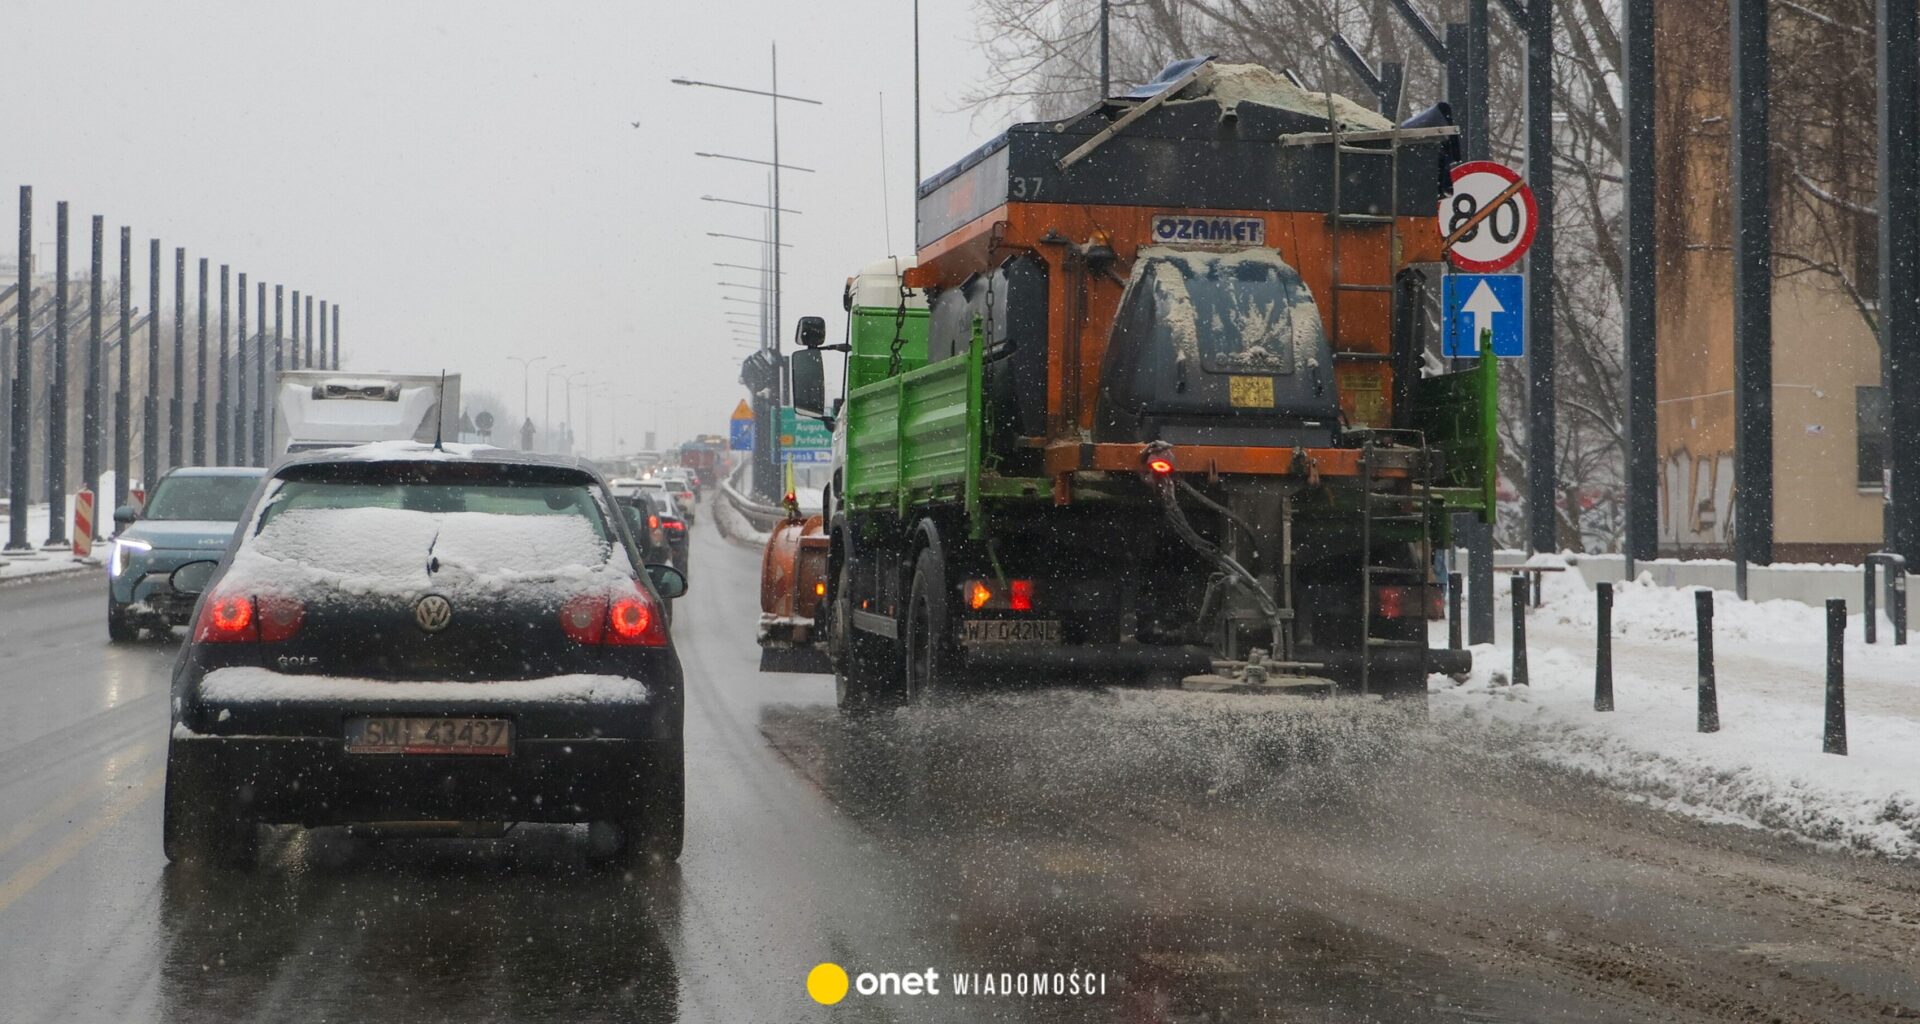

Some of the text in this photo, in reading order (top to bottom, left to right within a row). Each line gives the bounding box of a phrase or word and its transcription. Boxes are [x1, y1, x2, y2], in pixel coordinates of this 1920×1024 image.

[1012, 177, 1043, 198] 37
[1449, 193, 1520, 244] 80
[1156, 219, 1260, 241] OZAMET
[277, 654, 318, 666] GOLF
[425, 720, 505, 746] 43437
